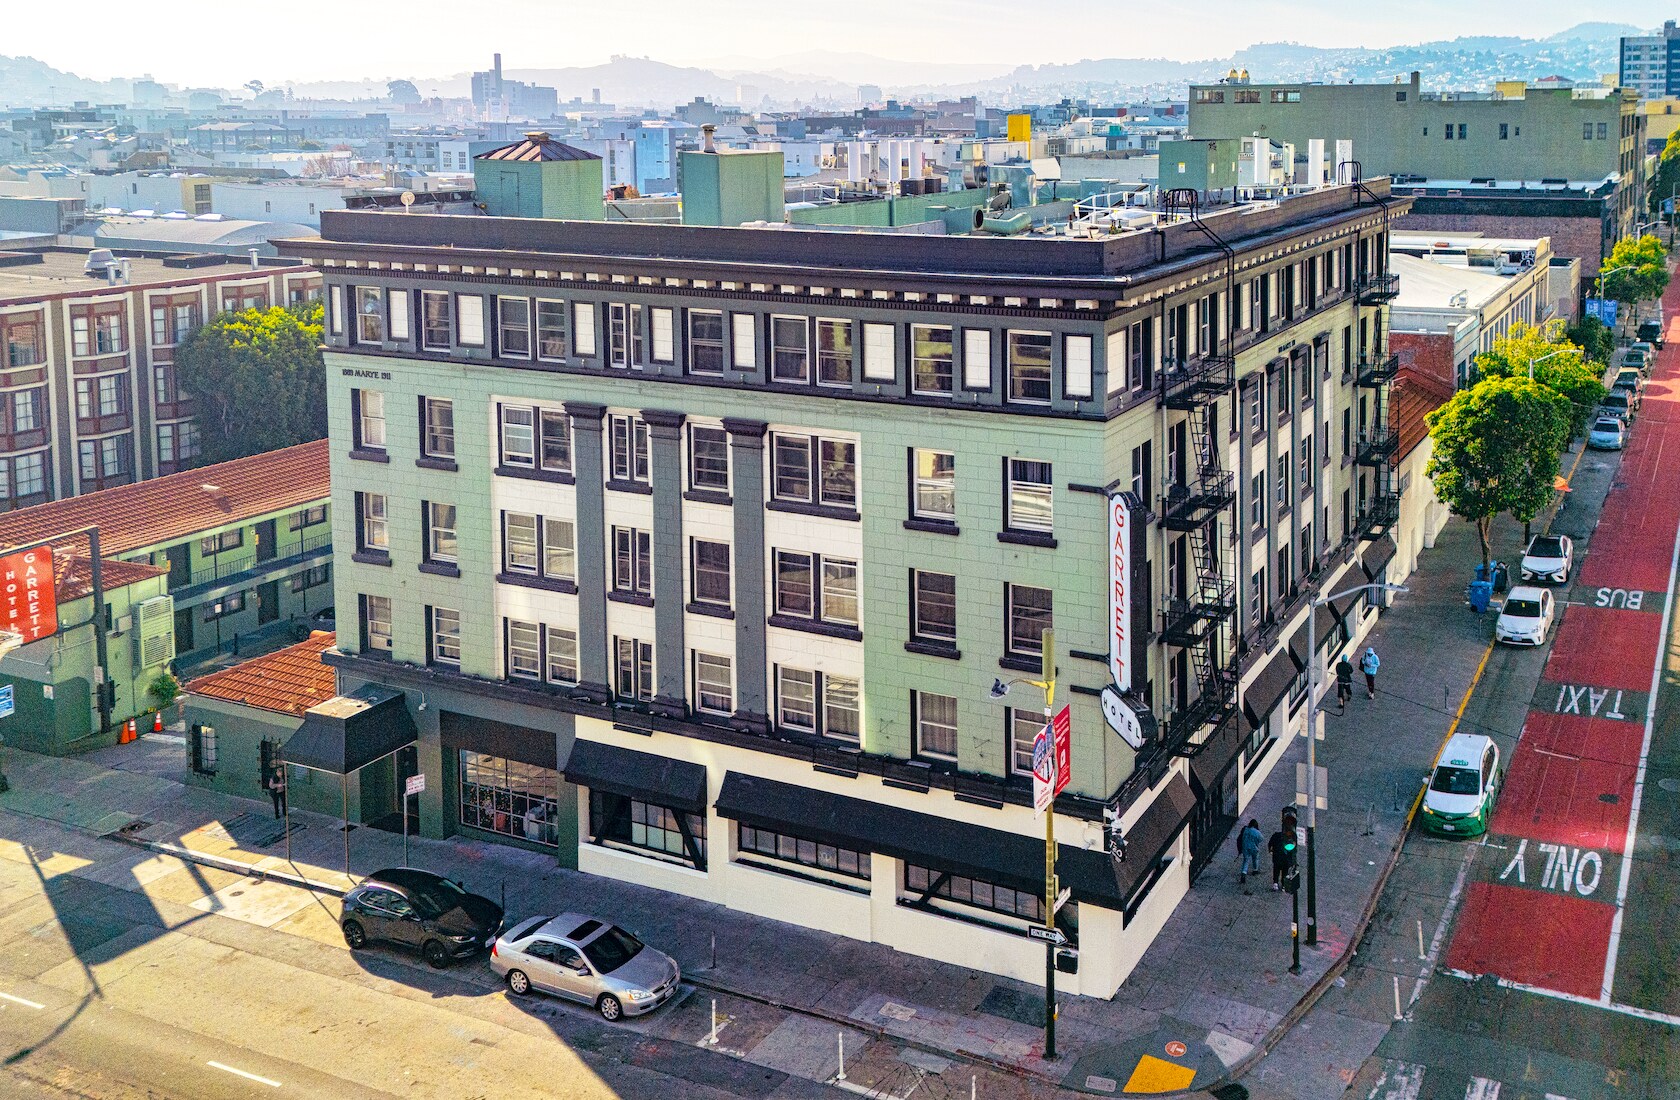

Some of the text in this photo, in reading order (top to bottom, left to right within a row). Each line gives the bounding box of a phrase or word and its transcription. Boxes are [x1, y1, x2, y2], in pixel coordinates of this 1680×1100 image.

[6, 571, 21, 633] HOTEL
[24, 553, 41, 637] GARRETT
[1114, 503, 1125, 683] GARRETT
[1595, 587, 1644, 610] BUS
[1103, 696, 1141, 739] HOTEL
[1555, 685, 1625, 720] TAXI
[1500, 839, 1603, 896] ONLY
